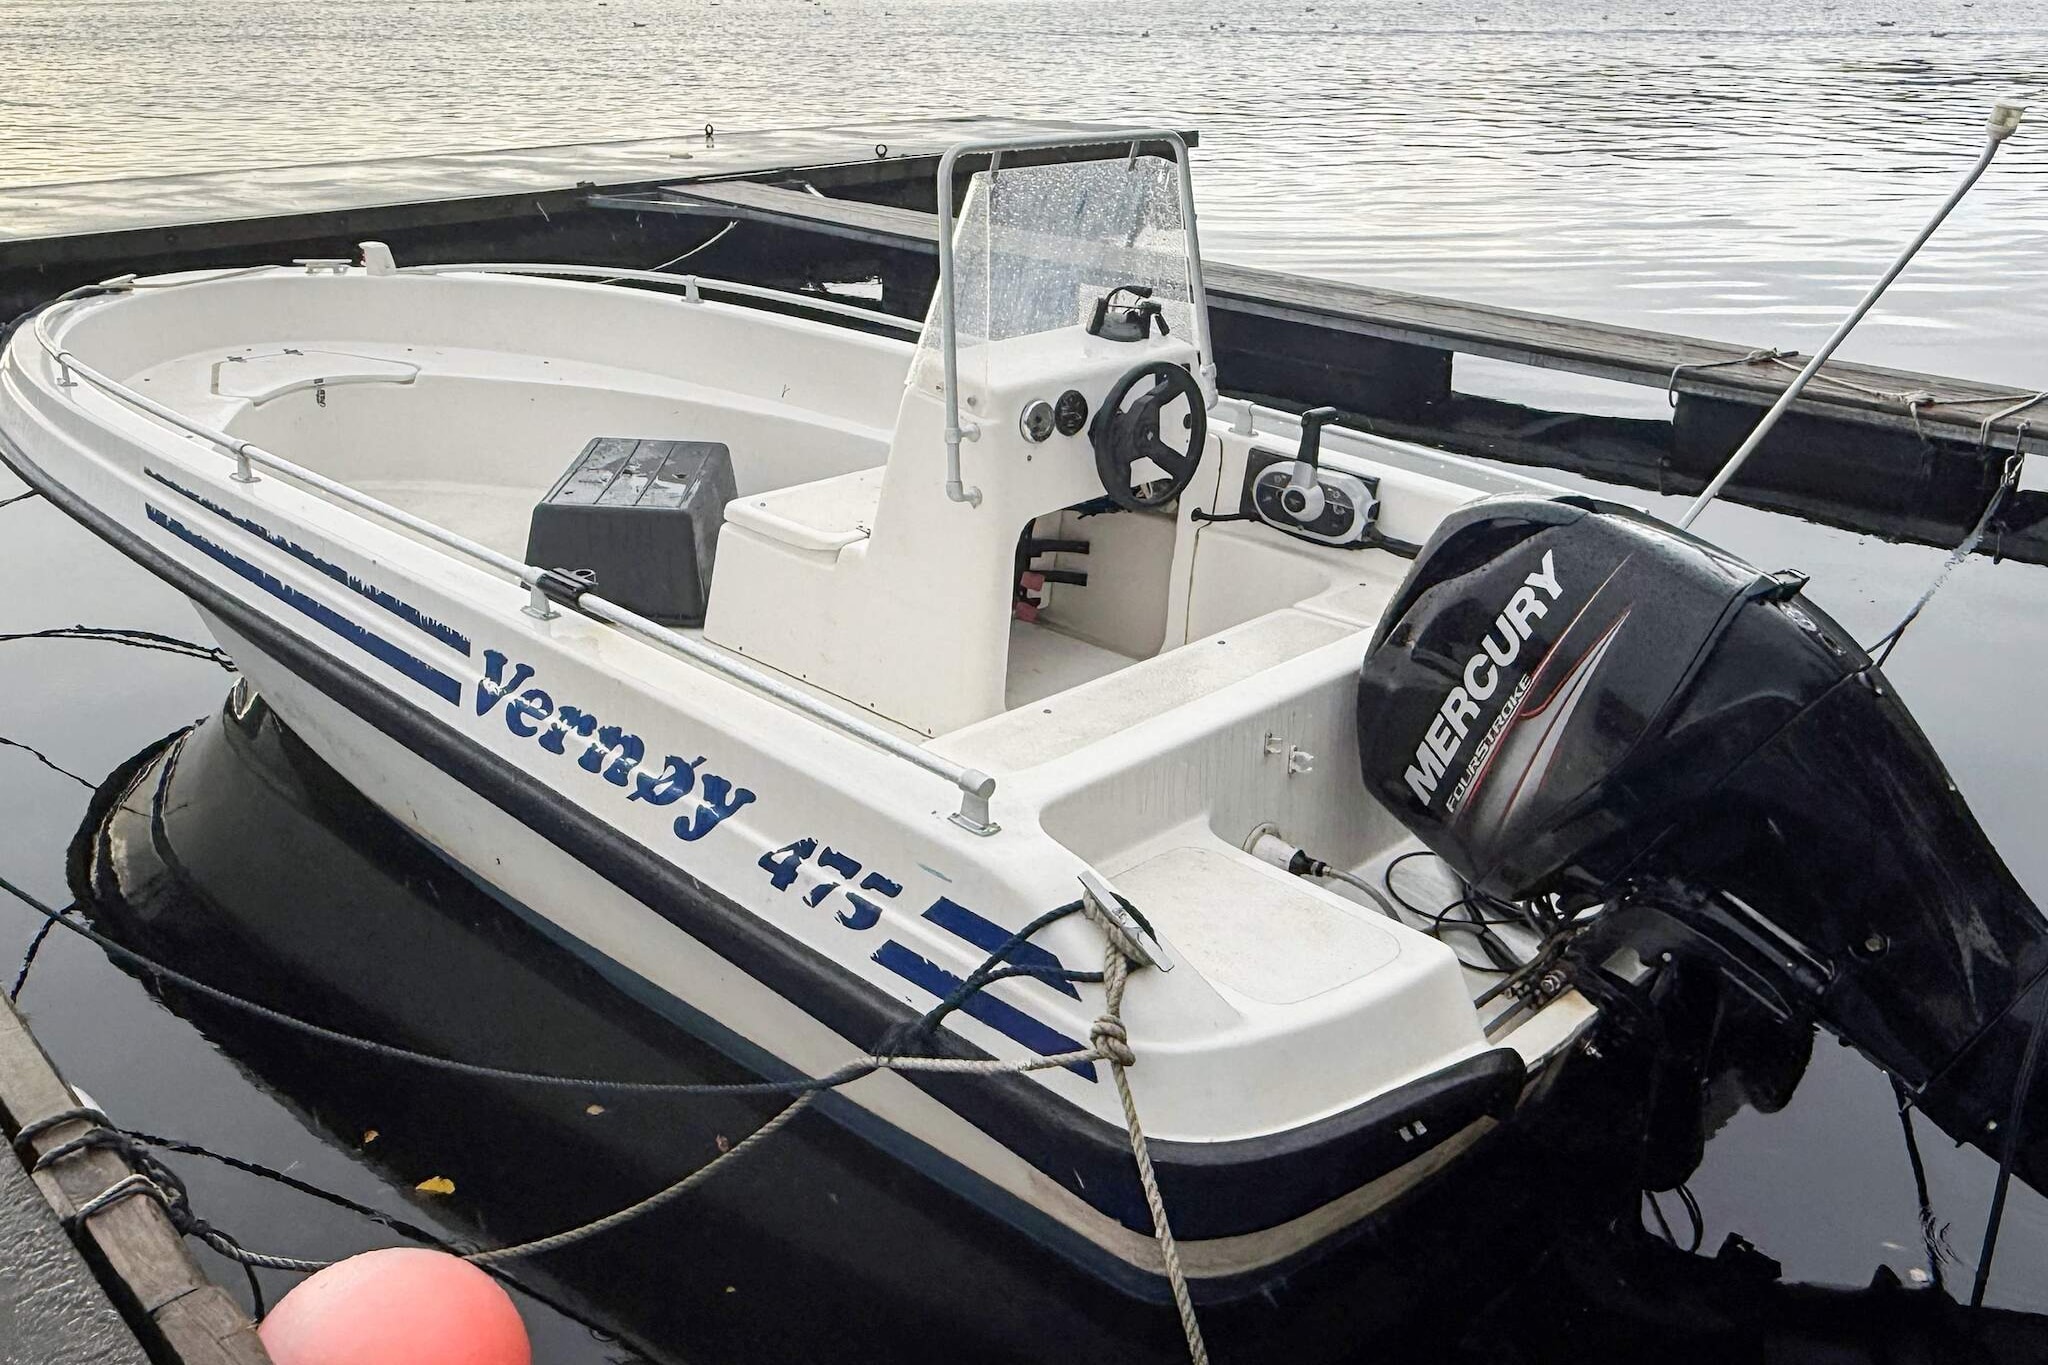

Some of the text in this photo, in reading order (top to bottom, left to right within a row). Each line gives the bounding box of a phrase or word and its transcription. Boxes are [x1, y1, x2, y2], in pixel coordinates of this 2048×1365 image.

[1403, 549, 1563, 806] MERCURY
[1445, 673, 1531, 813] FOURSTROKE
[758, 837, 903, 931] 475
